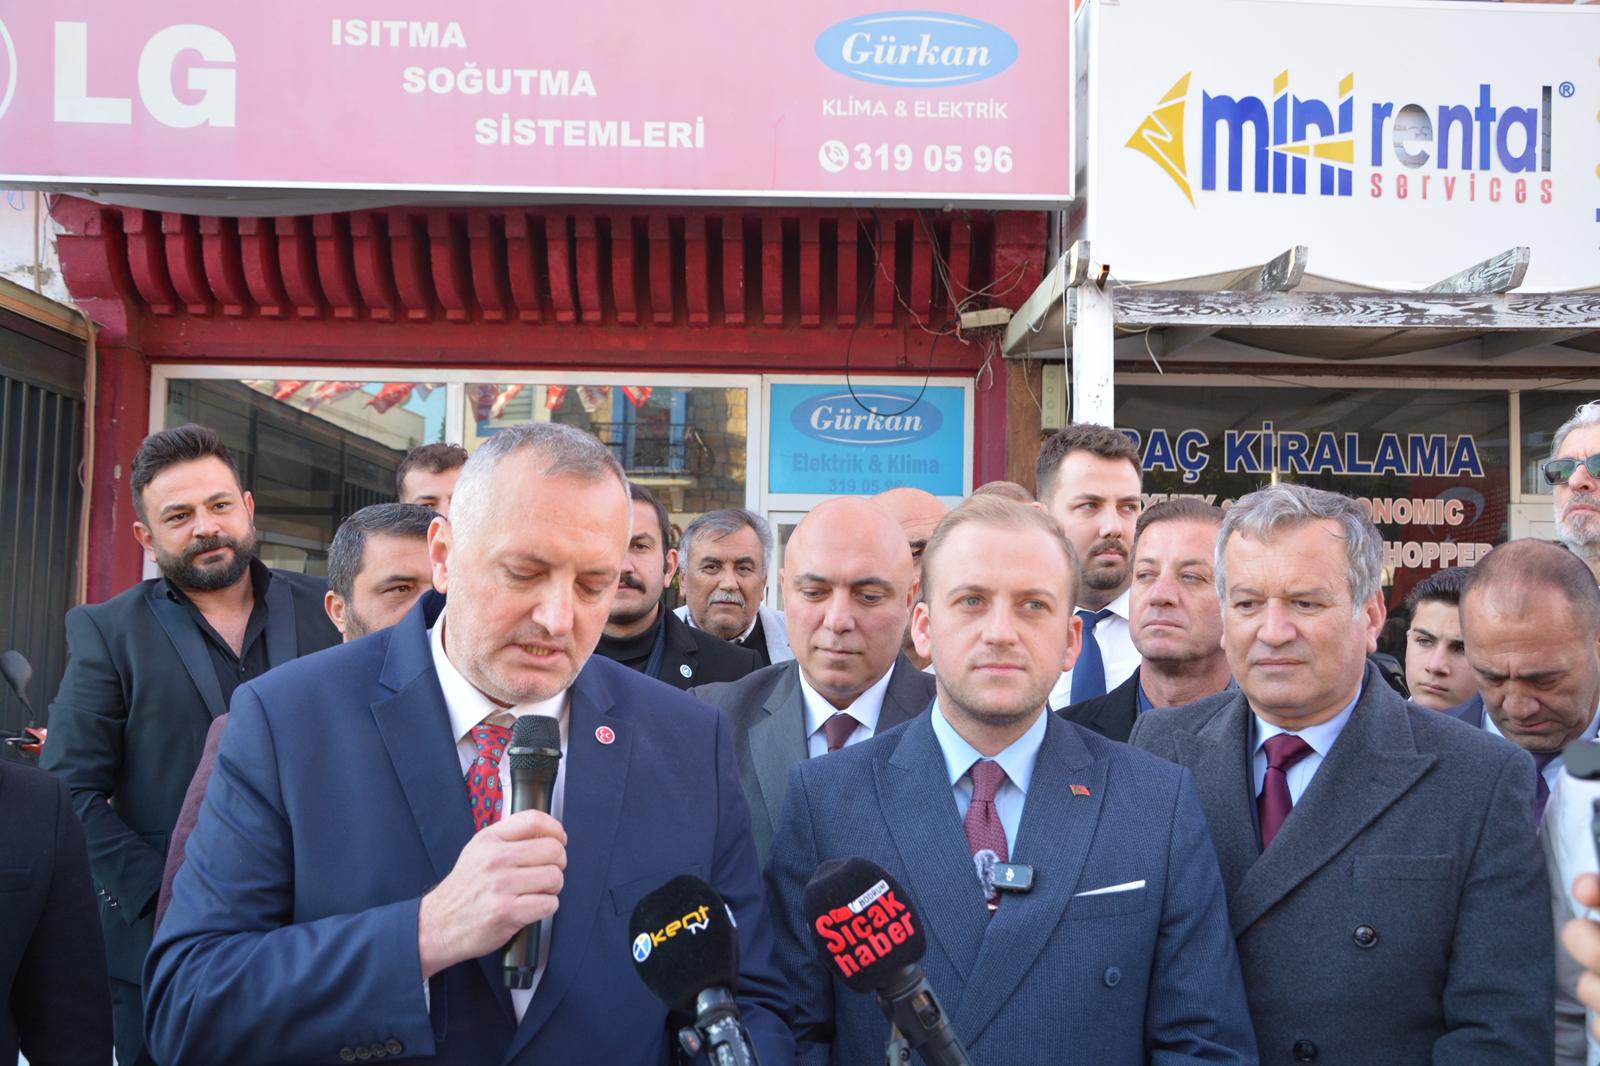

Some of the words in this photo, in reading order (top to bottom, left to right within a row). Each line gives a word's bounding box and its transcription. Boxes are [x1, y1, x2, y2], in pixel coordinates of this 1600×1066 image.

[331, 19, 467, 48] ISITMA
[842, 32, 991, 67] Gürkan
[53, 21, 237, 128] LG
[402, 61, 597, 97] SOĞUTMA
[822, 96, 887, 117] KLİMA
[895, 100, 907, 117] &
[914, 98, 1008, 119] ELEKTRİK
[474, 114, 705, 149] SİSTEMLERİ
[1202, 69, 1354, 196] mini
[1371, 83, 1552, 174] rental
[853, 143, 912, 171] 319
[924, 145, 962, 172] 05
[974, 146, 1013, 173] 96
[1371, 173, 1553, 205] services
[810, 405, 923, 432] Gürkan
[792, 453, 863, 473] Elektrik
[869, 454, 882, 473] &
[887, 454, 940, 474] Klima
[1224, 421, 1485, 477] KİRALAMA
[687, 918, 710, 935] TV
[834, 911, 915, 977] haber
